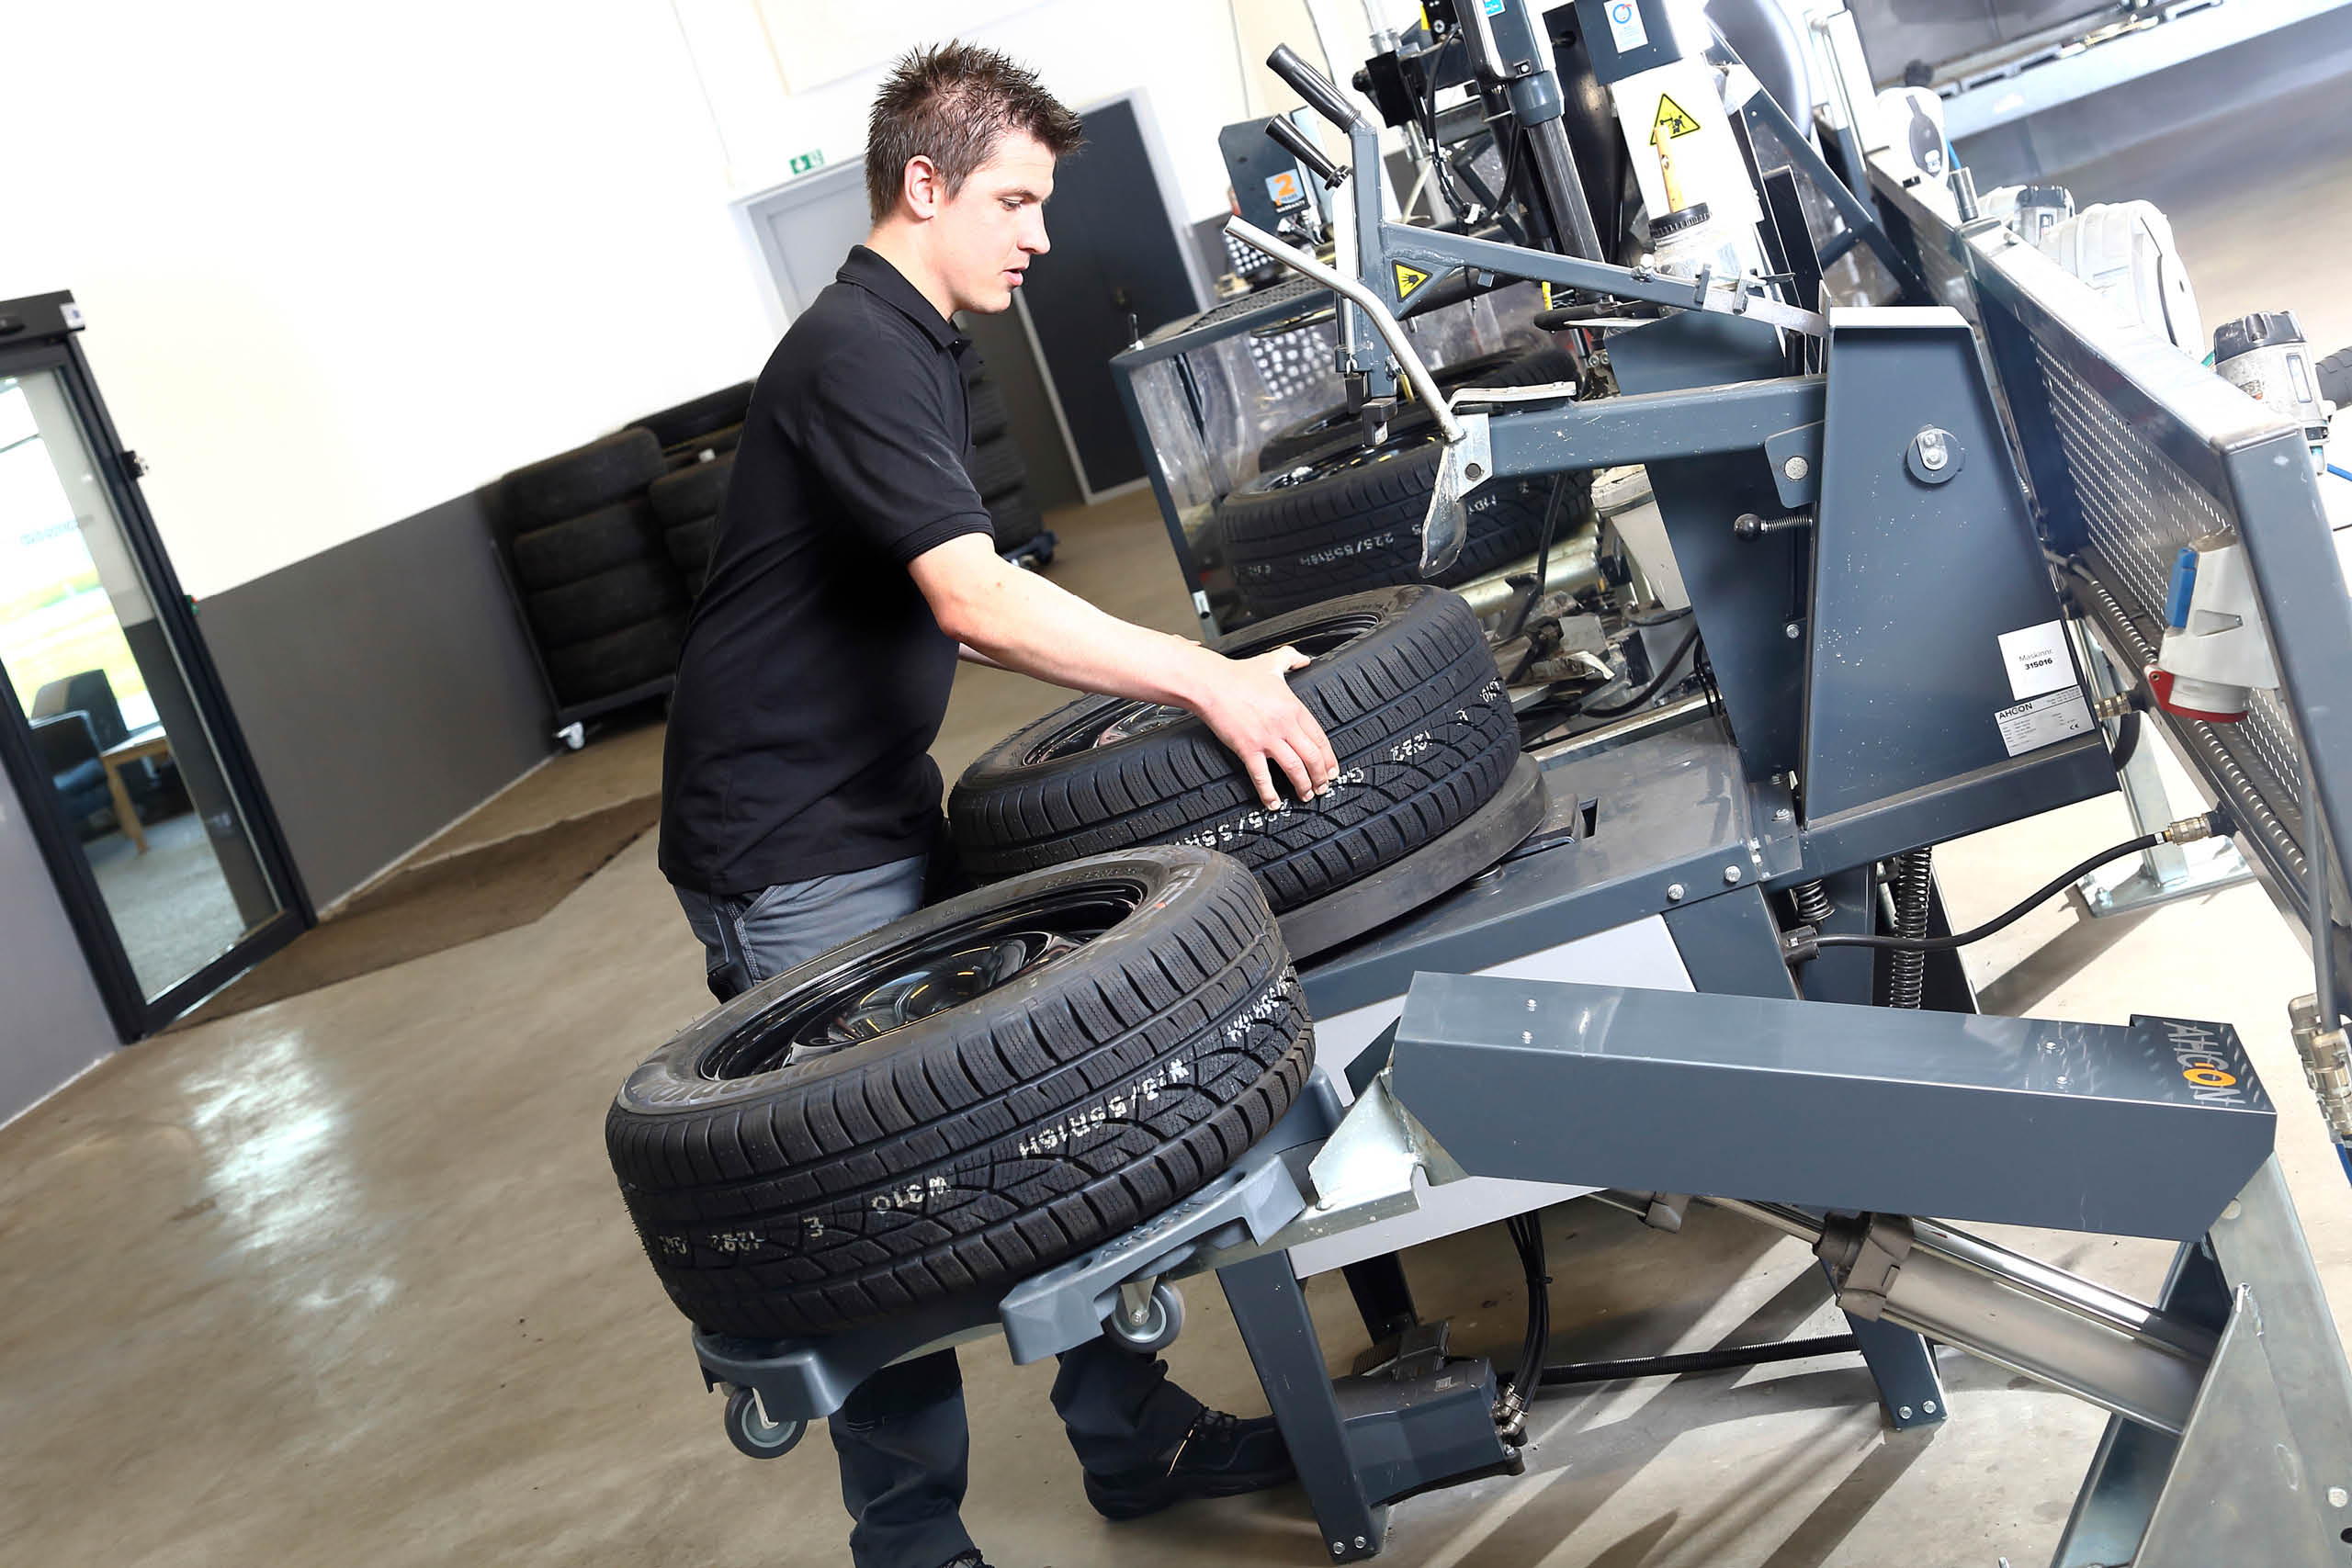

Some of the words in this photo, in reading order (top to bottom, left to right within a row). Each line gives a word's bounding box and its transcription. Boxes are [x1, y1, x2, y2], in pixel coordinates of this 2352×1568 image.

[1273, 173, 1296, 197] 2
[2024, 657, 2053, 671] 315016
[1998, 702, 2033, 720] AHCON
[2162, 1021, 2246, 1106] AHCON
